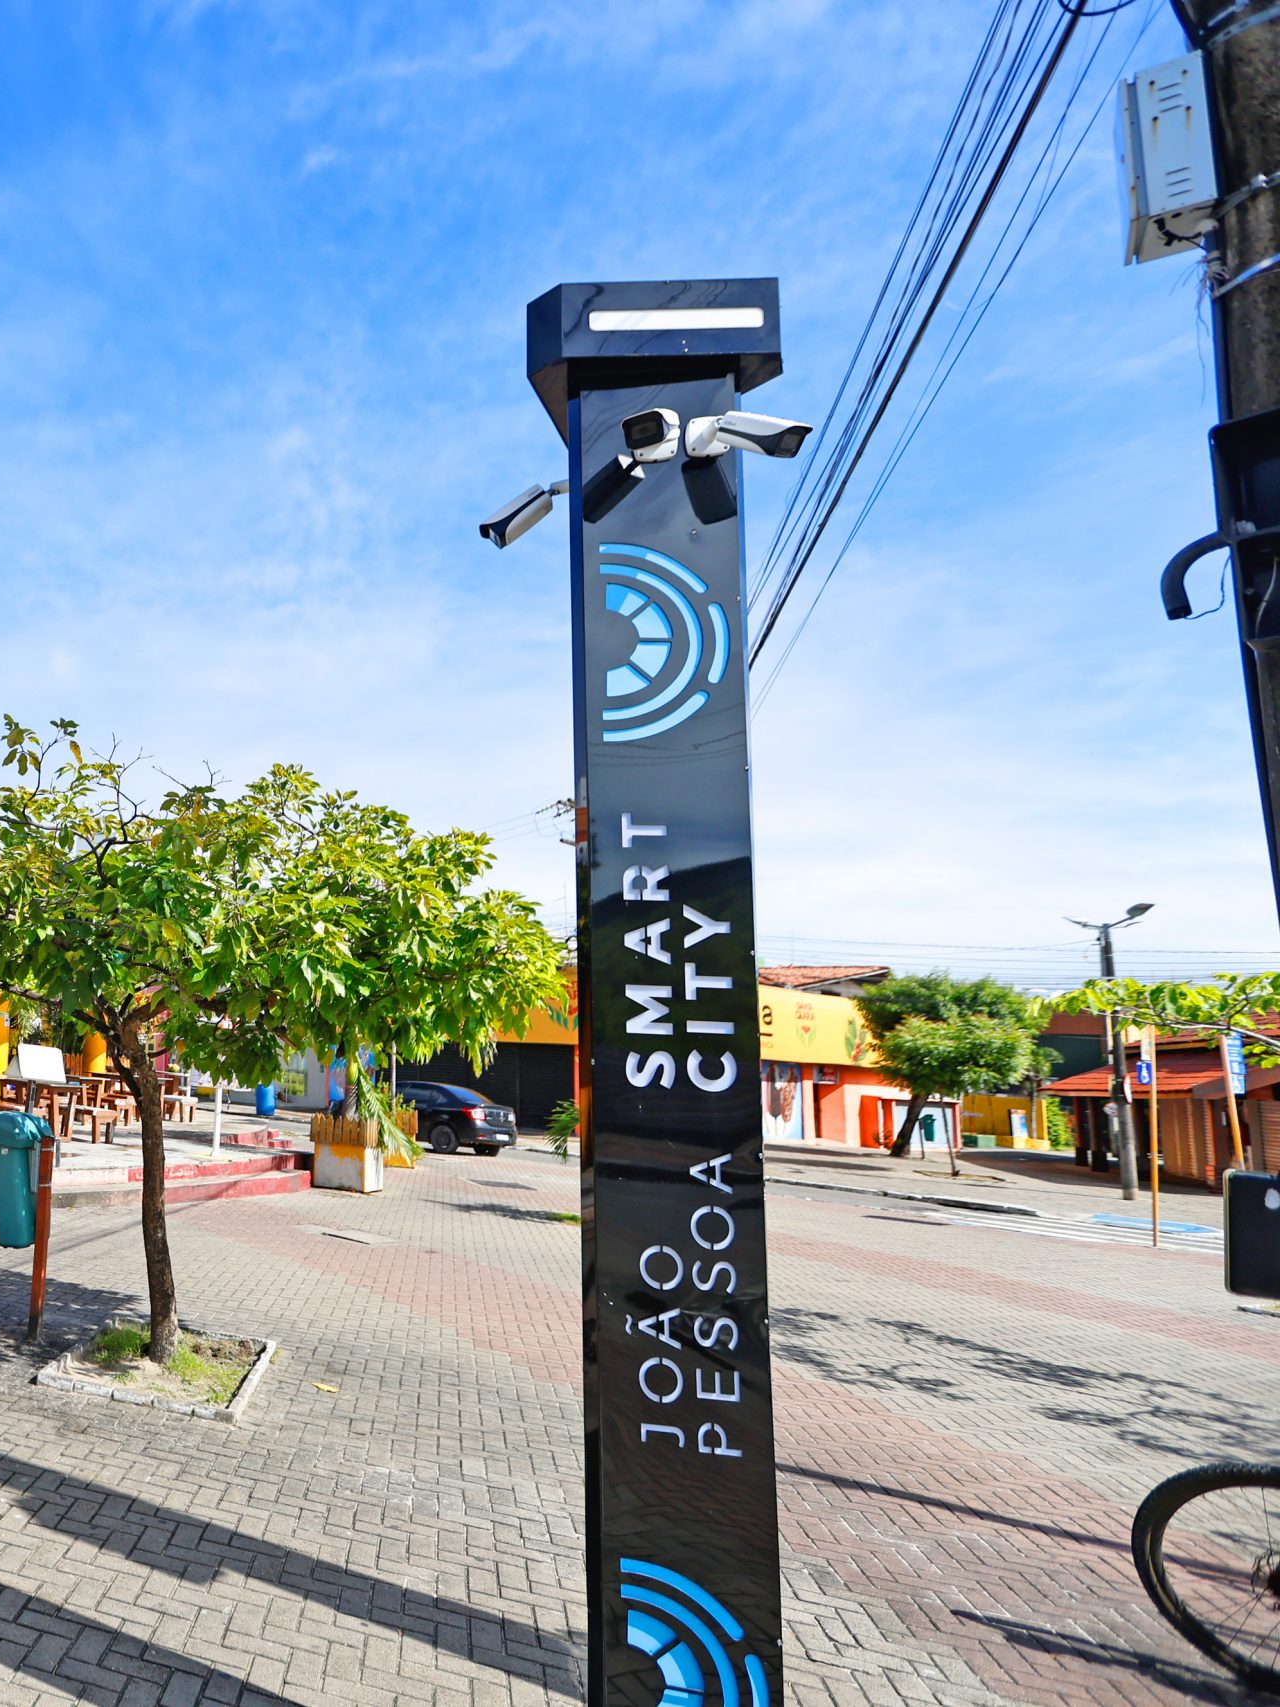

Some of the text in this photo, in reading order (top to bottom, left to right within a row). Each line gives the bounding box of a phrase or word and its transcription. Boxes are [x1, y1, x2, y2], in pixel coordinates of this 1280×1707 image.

[622, 812, 676, 1090] SMART
[683, 904, 738, 1093] CITY
[626, 1244, 685, 1448] JOÃO
[690, 1152, 742, 1458] PESSOA
